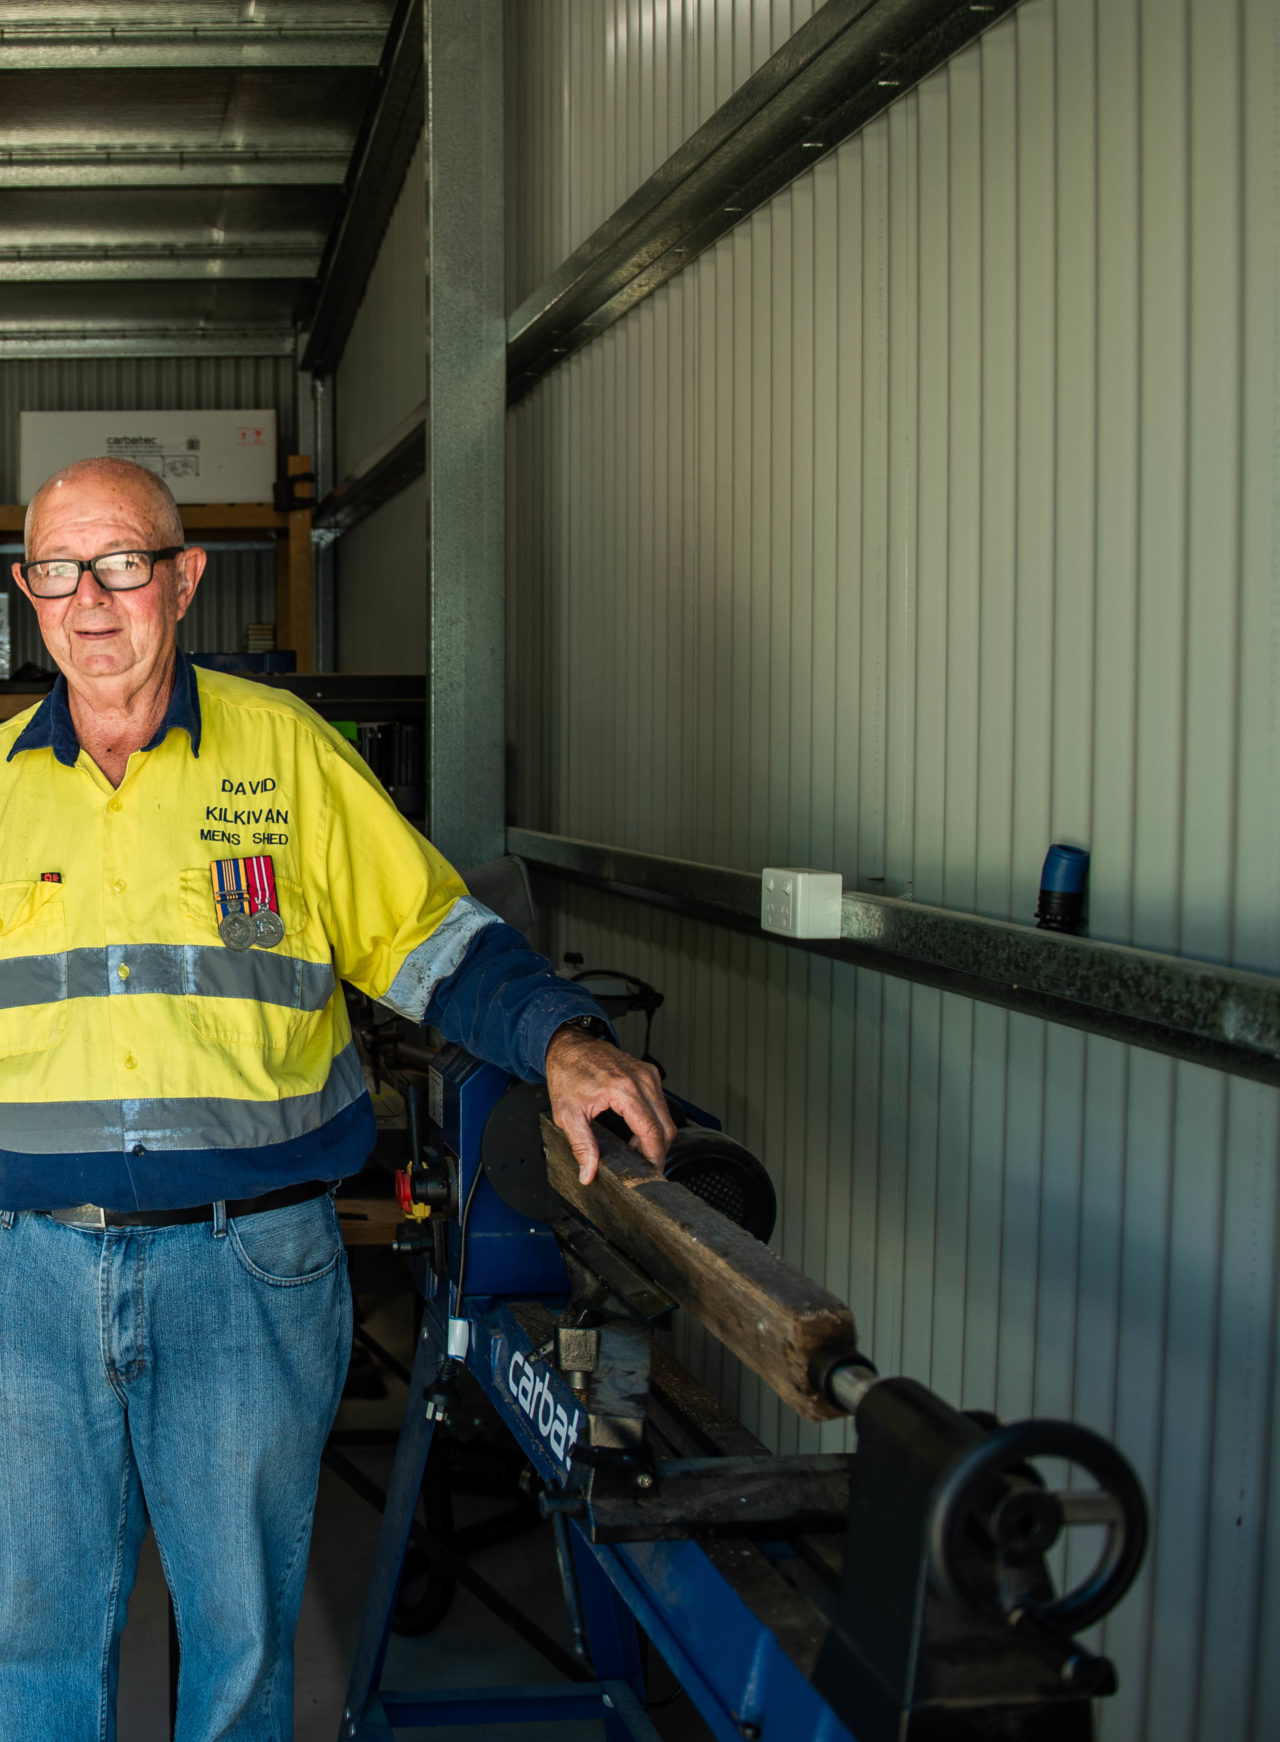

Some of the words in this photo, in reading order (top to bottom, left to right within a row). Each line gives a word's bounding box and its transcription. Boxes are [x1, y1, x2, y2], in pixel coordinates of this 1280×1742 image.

[106, 435, 157, 446] carbatec
[221, 777, 277, 796] DAVID
[205, 805, 289, 826] KILKIVAN
[200, 828, 242, 846] MENS
[251, 832, 289, 846] SHED
[508, 1350, 580, 1472] carbat
